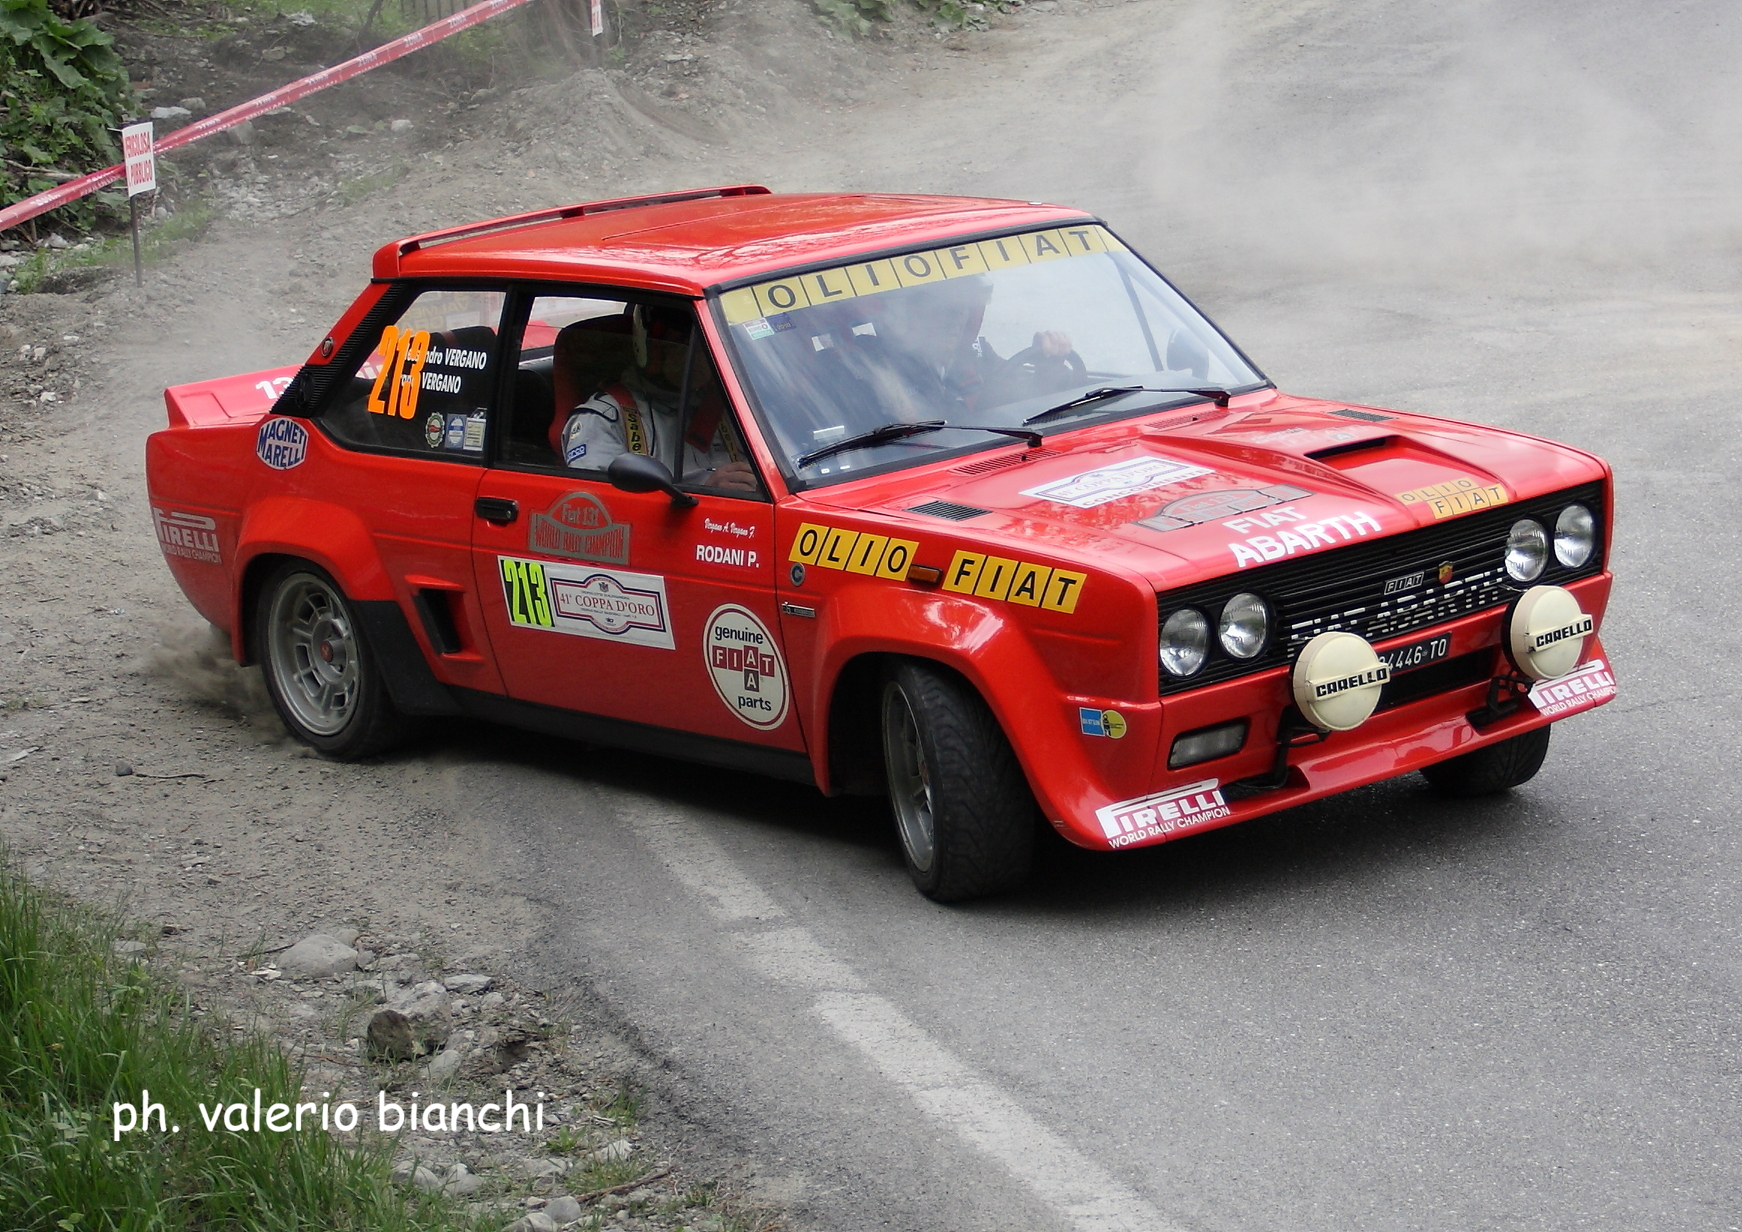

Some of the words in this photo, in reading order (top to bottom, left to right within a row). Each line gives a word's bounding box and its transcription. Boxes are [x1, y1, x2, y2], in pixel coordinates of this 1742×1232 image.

[367, 325, 431, 419] 213
[444, 348, 487, 370] VERGANO
[421, 372, 461, 394] VERGANO
[1402, 480, 1472, 502] OLIO
[1435, 487, 1500, 513] FIAT
[1222, 506, 1307, 534] FIAT
[799, 529, 908, 573] OLIO
[1228, 511, 1382, 568] ABARTH
[696, 544, 744, 566] RODANI
[747, 551, 760, 568] P.
[503, 558, 552, 627] 213
[953, 558, 1077, 606] FIAT
[1386, 573, 1423, 593] FIAT
[575, 595, 614, 611] COPPA
[616, 601, 655, 617] D'ORO
[715, 627, 764, 645] genuine
[1535, 619, 1592, 648] CARELLO
[716, 649, 772, 673] FIAT
[1430, 638, 1447, 660] TO
[1316, 668, 1388, 697] CARELLO
[1528, 659, 1615, 708] PIRELLI
[738, 696, 772, 712] parts
[1540, 702, 1567, 716] WORLD
[1095, 778, 1226, 839] PIRELLI
[1108, 829, 1147, 849] WORLD
[1148, 821, 1176, 837] RALLY
[1177, 807, 1231, 828] CHAMPION
